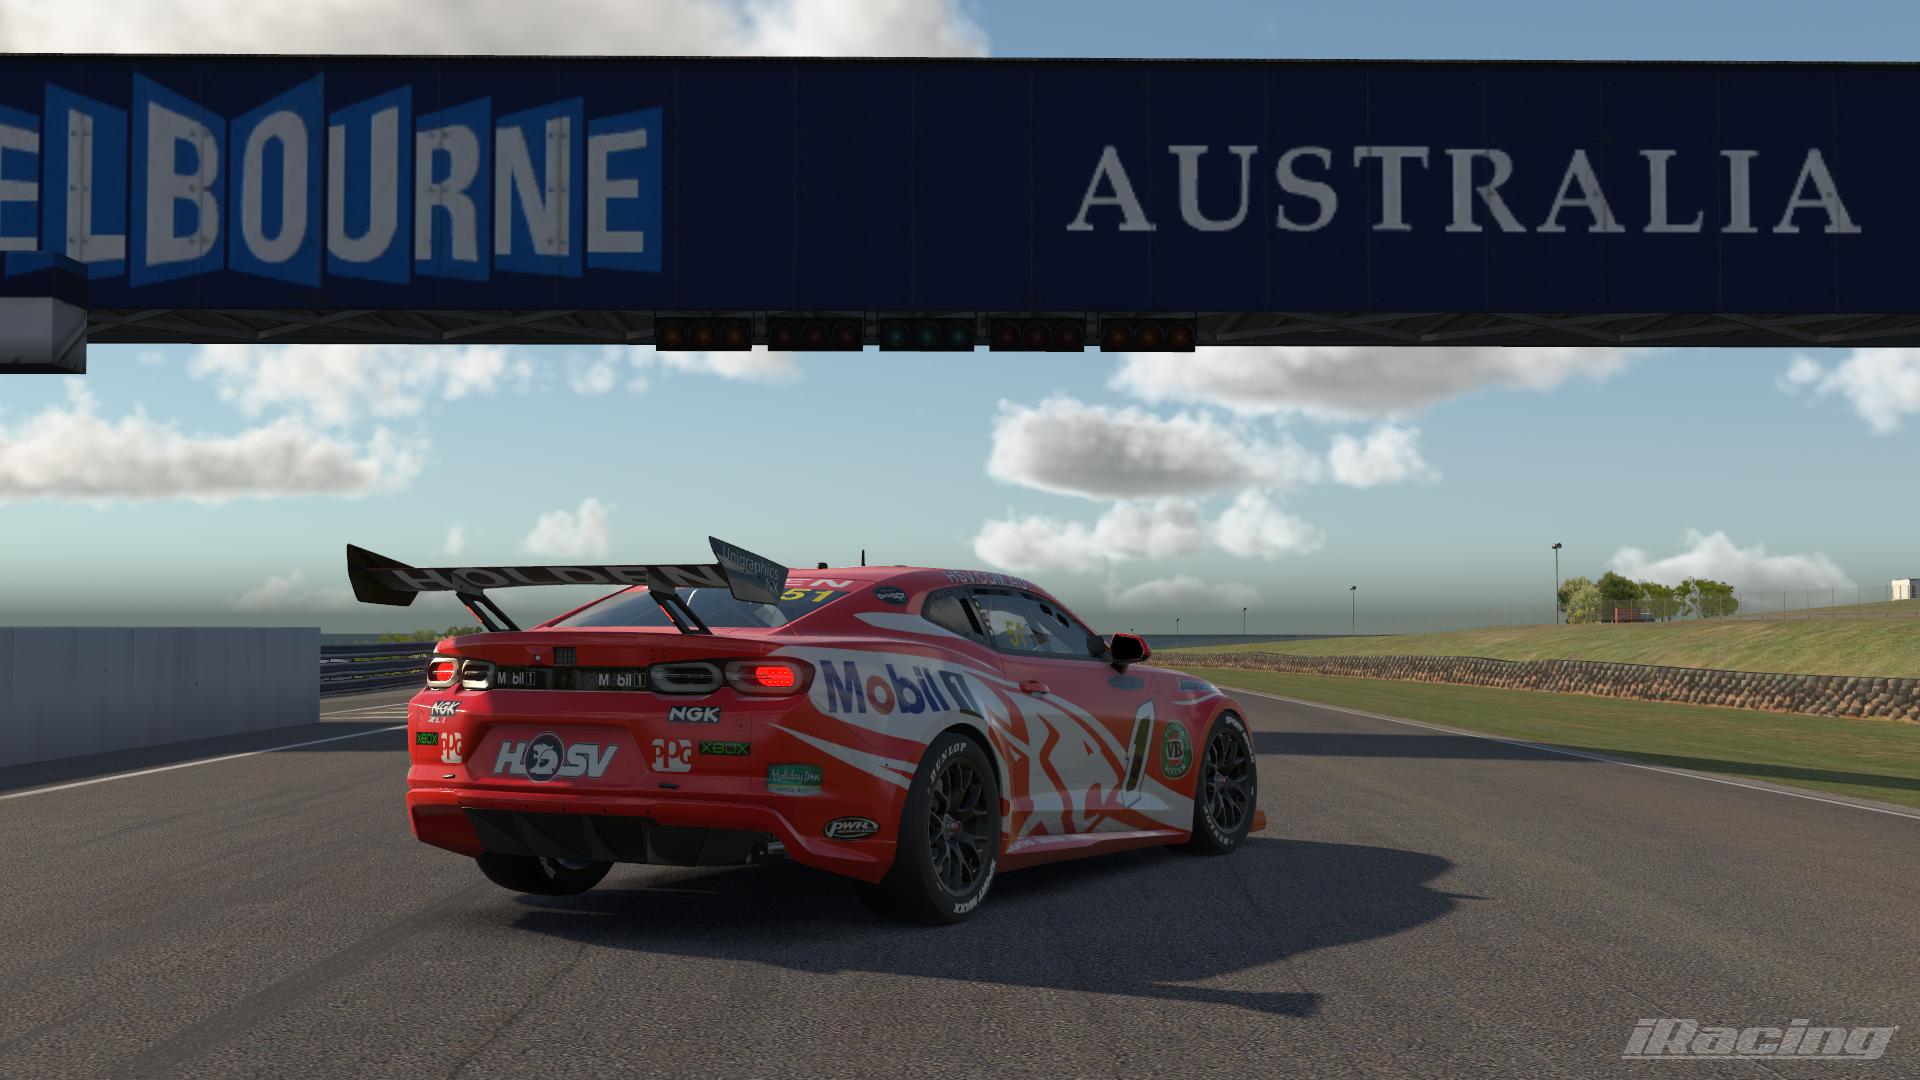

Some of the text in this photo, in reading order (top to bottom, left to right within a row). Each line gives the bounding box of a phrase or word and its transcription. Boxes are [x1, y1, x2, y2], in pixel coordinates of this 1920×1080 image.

[1066, 145, 1863, 234] AUSTRALIA
[722, 545, 779, 580] Unigraphics
[390, 565, 731, 591] HOLDEN
[780, 588, 834, 602] 51
[819, 660, 950, 716] Mobil
[431, 700, 461, 715] NGK
[669, 706, 720, 723] NGK
[416, 733, 438, 744] XBOX
[702, 742, 749, 754] XBOX
[1167, 739, 1185, 759] VB
[929, 742, 967, 785] DUNLOP
[770, 767, 820, 785] Holiday Inn
